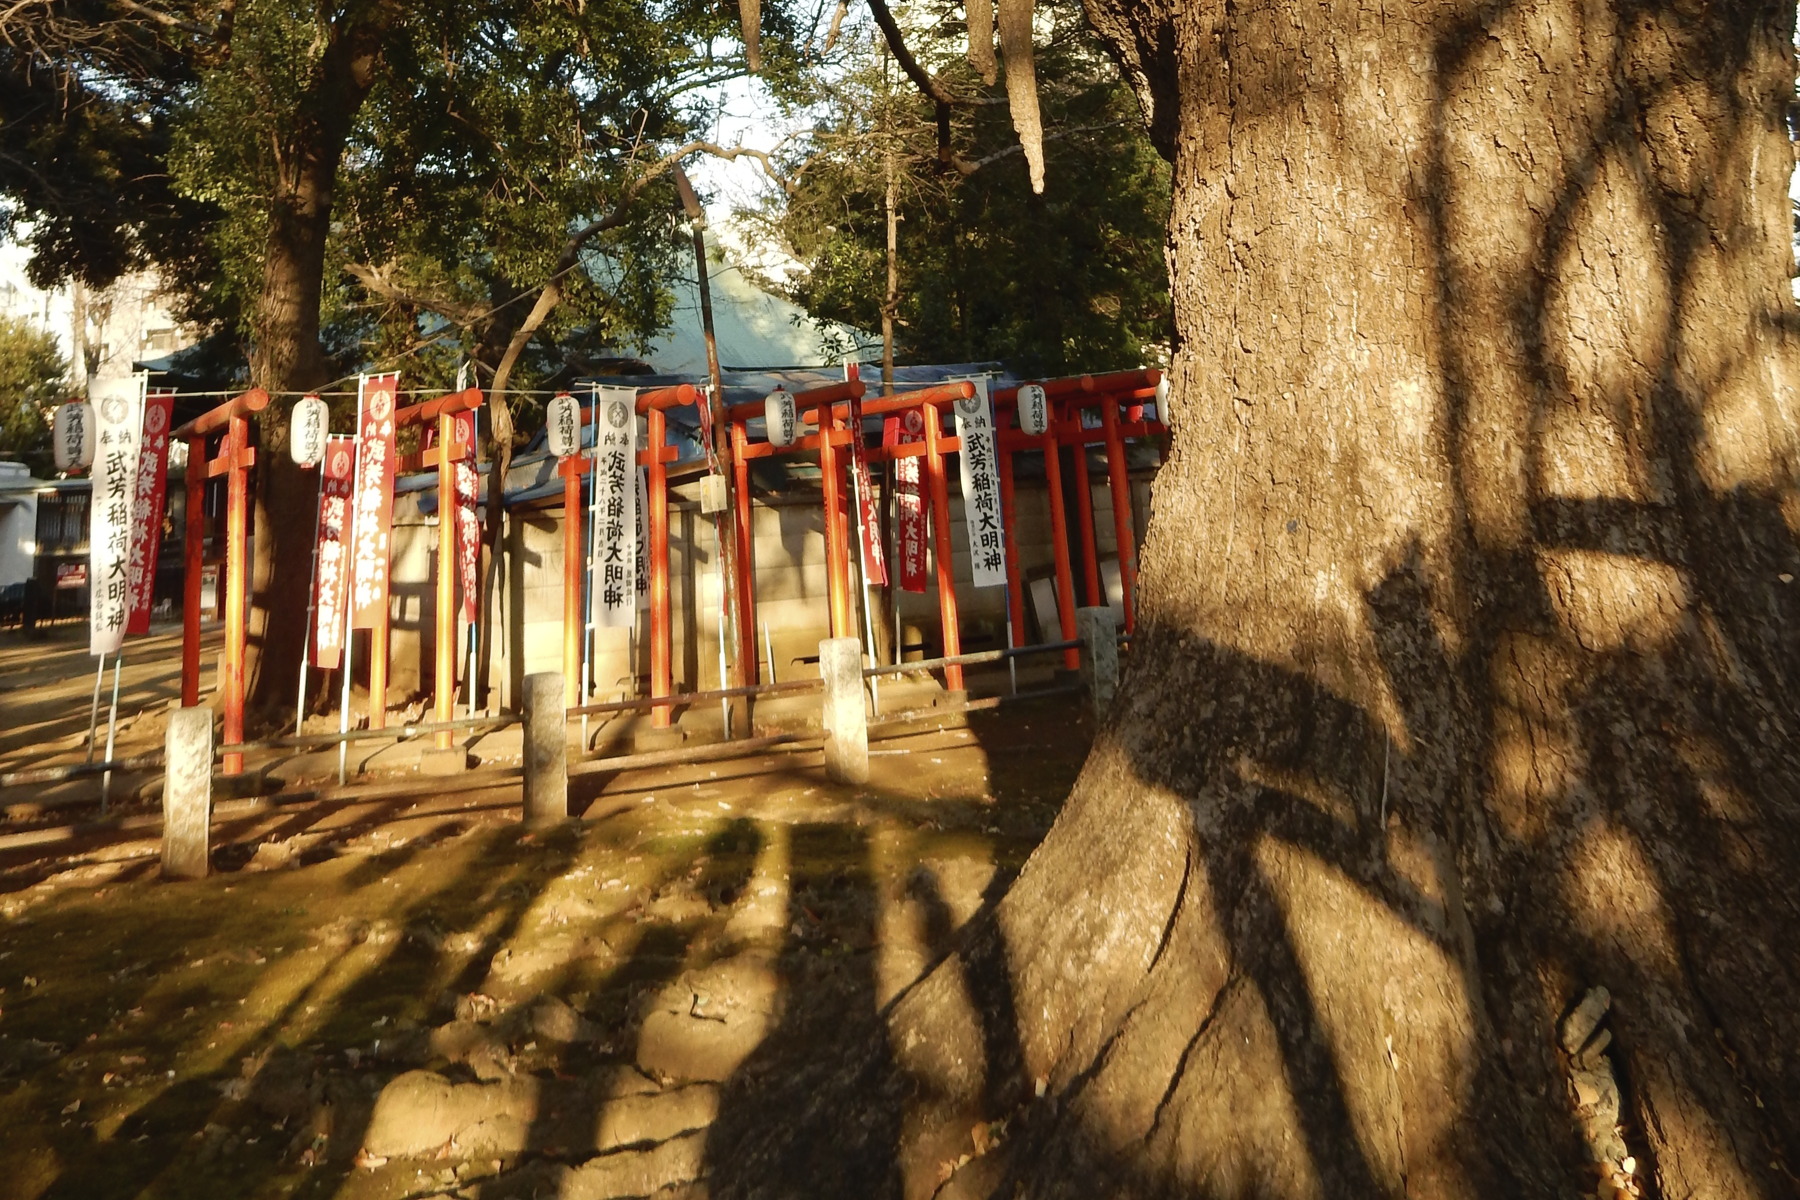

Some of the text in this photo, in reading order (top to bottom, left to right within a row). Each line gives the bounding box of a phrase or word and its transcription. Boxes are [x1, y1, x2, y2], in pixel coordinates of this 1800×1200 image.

[100, 428, 132, 445] 奉納
[961, 415, 986, 430] 奉納
[967, 432, 1001, 572] 武芳稲荷大明神
[106, 450, 128, 634] 武芳稲荷大明神
